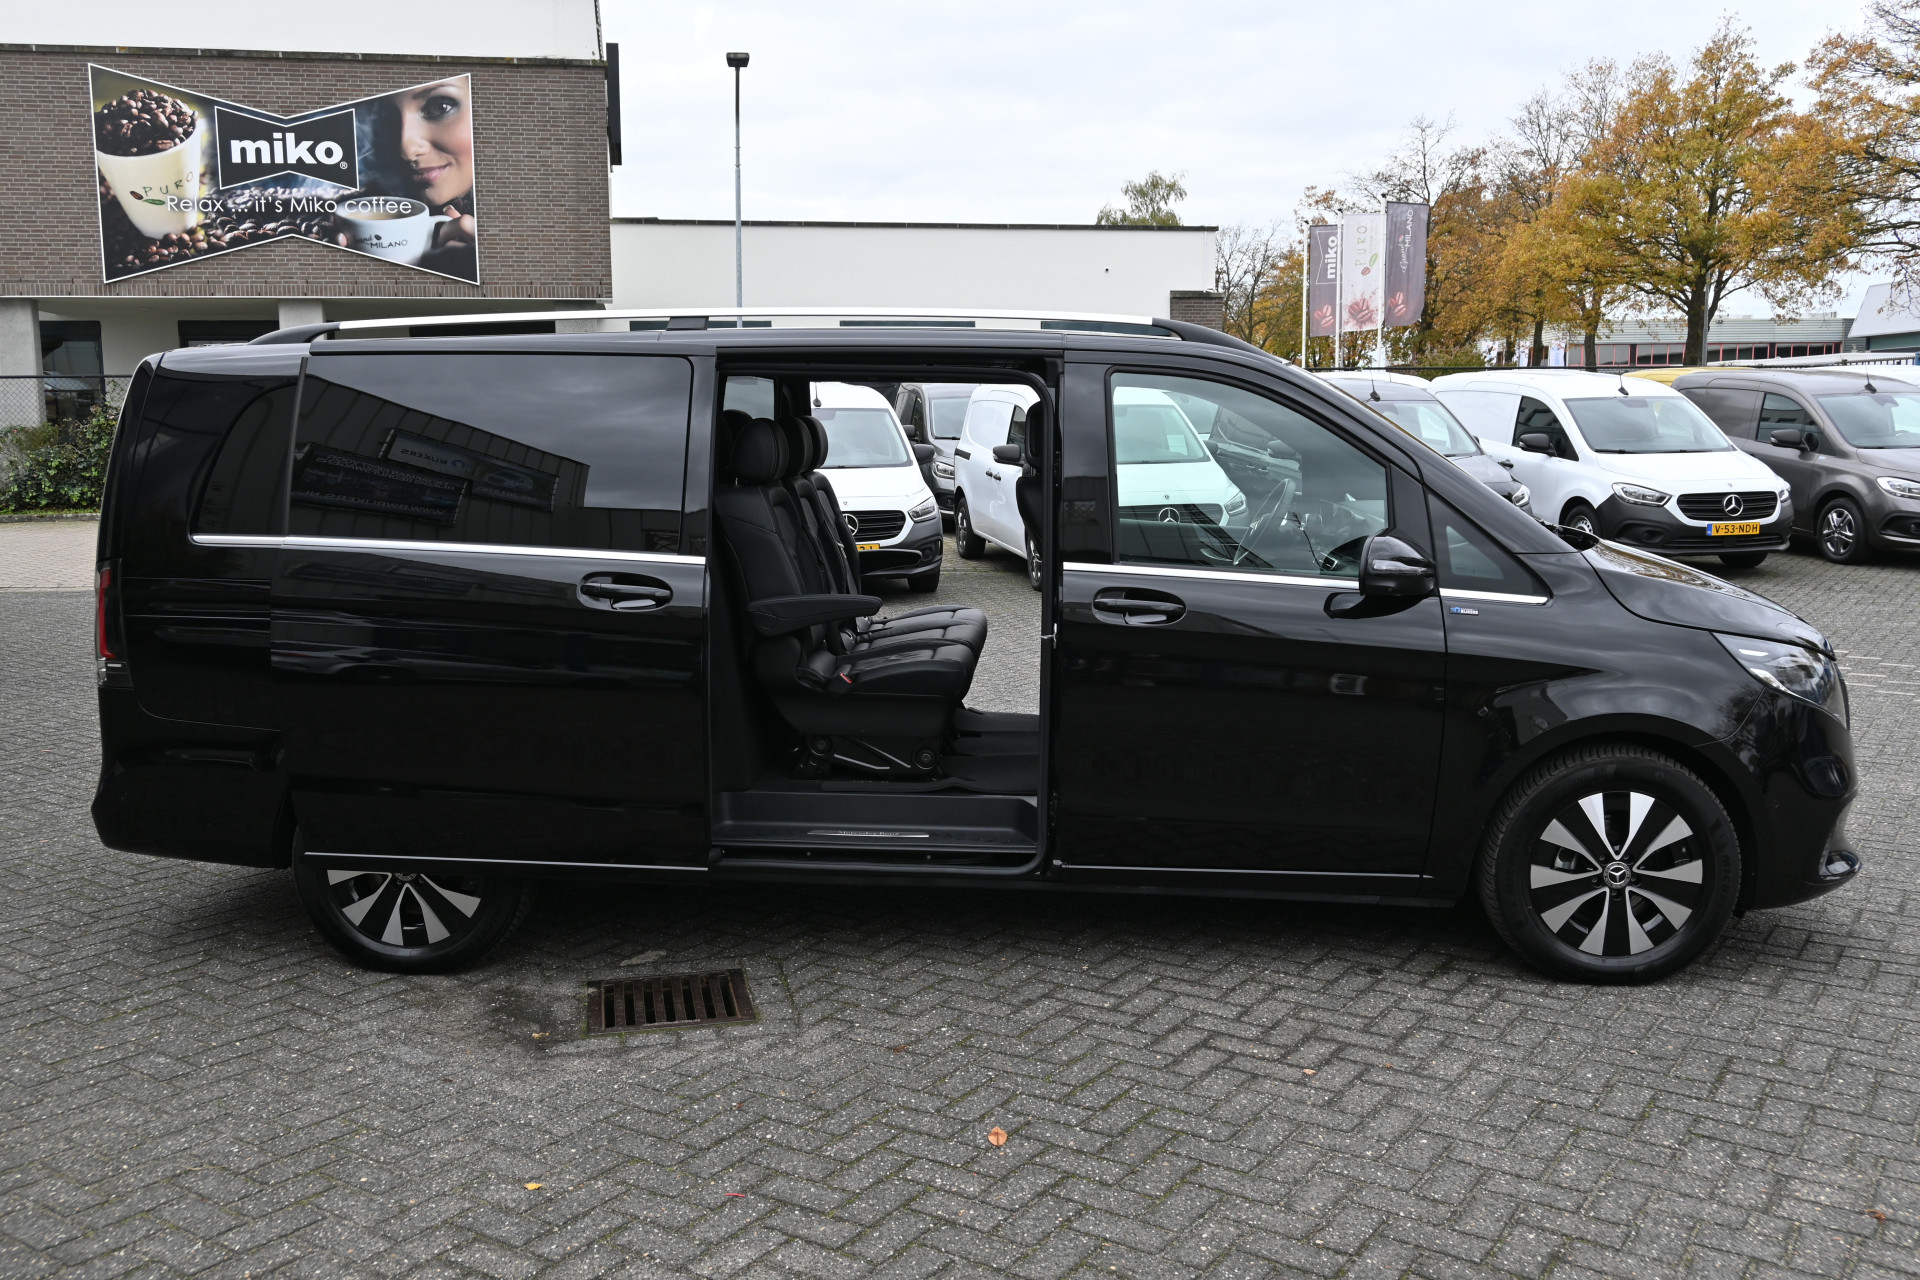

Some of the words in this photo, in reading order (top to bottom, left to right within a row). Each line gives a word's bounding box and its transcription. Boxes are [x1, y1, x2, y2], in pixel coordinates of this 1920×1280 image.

[230, 132, 344, 165] miko
[142, 171, 195, 198] PURO
[167, 196, 225, 213] Relax
[255, 196, 283, 213] it's
[290, 196, 338, 213] Miko
[348, 196, 412, 214] coffee
[1404, 209, 1414, 247] MILANO
[370, 239, 408, 249] MILANO
[1324, 235, 1338, 279] miko
[1354, 225, 1368, 266] PURO
[1714, 523, 1758, 534] V-53-NDH
